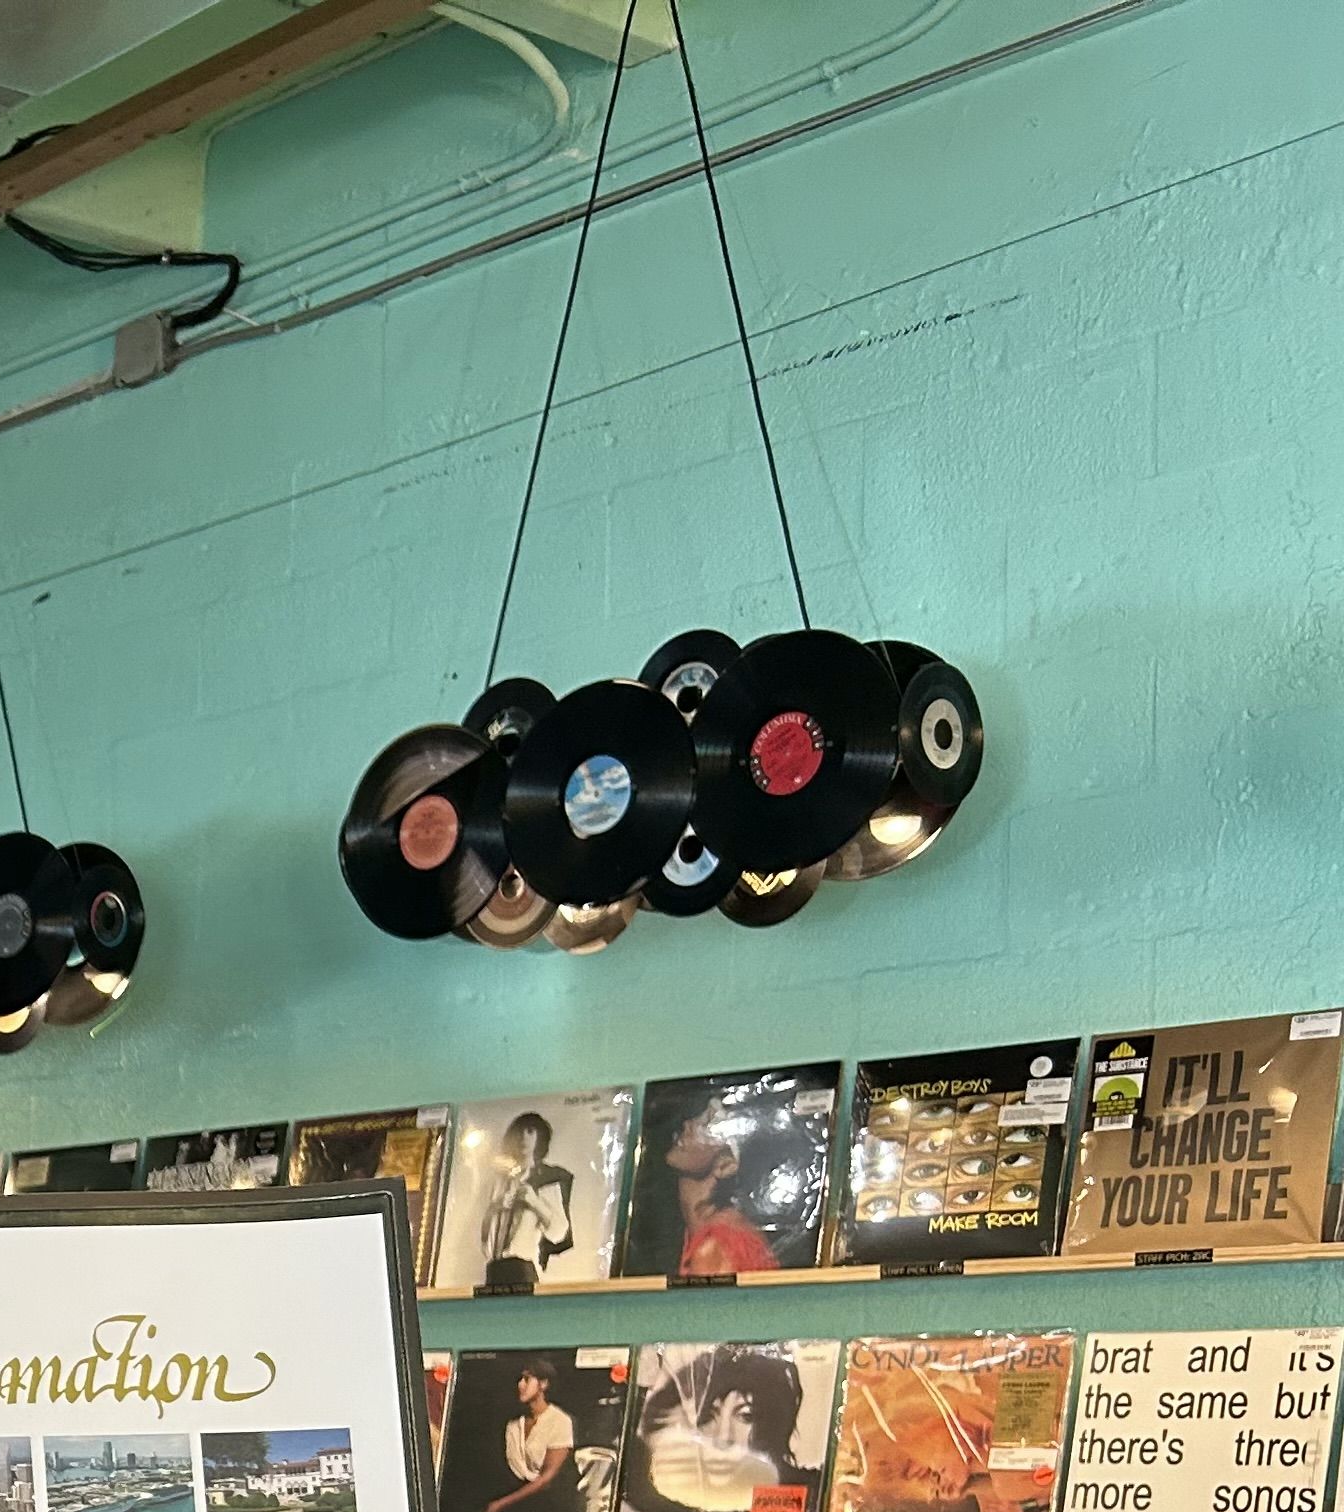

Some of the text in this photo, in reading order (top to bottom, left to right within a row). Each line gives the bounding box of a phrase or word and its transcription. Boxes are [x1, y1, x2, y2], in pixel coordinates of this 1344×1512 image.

[870, 1078, 992, 1102] DESTROY BOYS
[1162, 1050, 1251, 1108] IT'LL
[1129, 1107, 1274, 1169] CHANGE
[1100, 1166, 1292, 1229] YOUR LIFE
[928, 1210, 1039, 1234] MAKE ROOM
[1089, 1340, 1153, 1374] brat
[1188, 1336, 1251, 1372] and
[1084, 1384, 1132, 1420] the
[1157, 1394, 1248, 1420] same
[1274, 1382, 1331, 1419] but
[1078, 1429, 1184, 1465] there's
[1072, 1483, 1152, 1511] more
